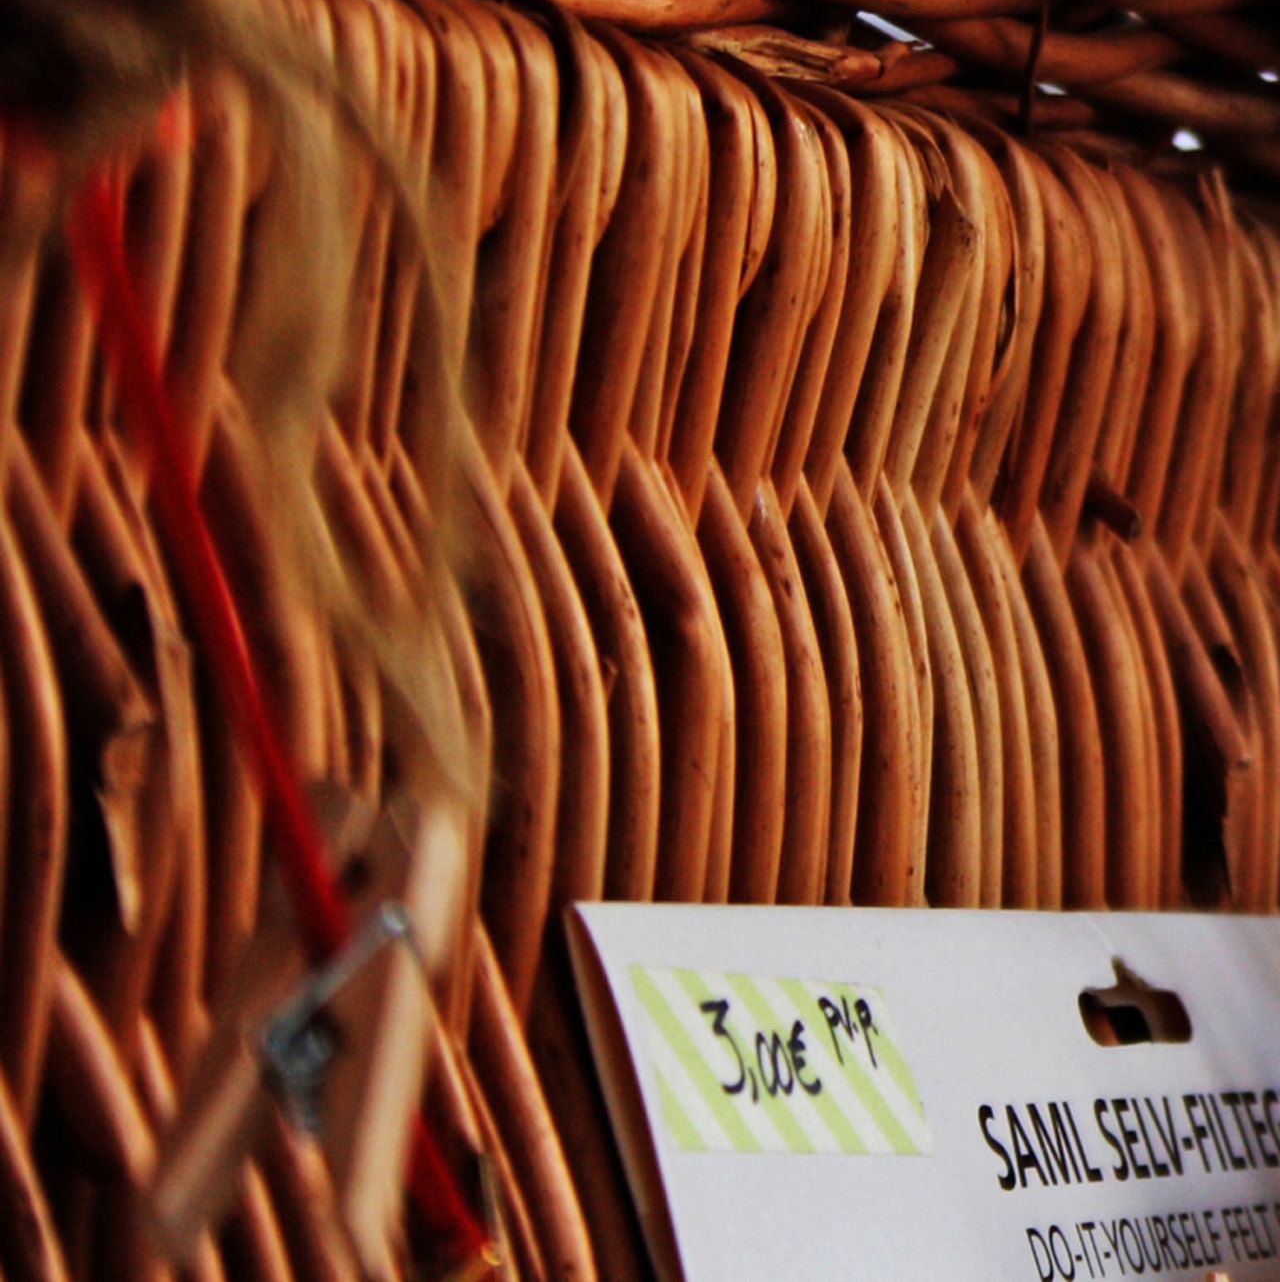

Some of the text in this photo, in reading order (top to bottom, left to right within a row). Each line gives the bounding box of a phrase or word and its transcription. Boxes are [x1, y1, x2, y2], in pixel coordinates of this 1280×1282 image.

[977, 1100, 1103, 1192] SAML
[1025, 1209, 1222, 1282] DO-IT-YOURSELF
[1221, 1204, 1277, 1261] FELT
